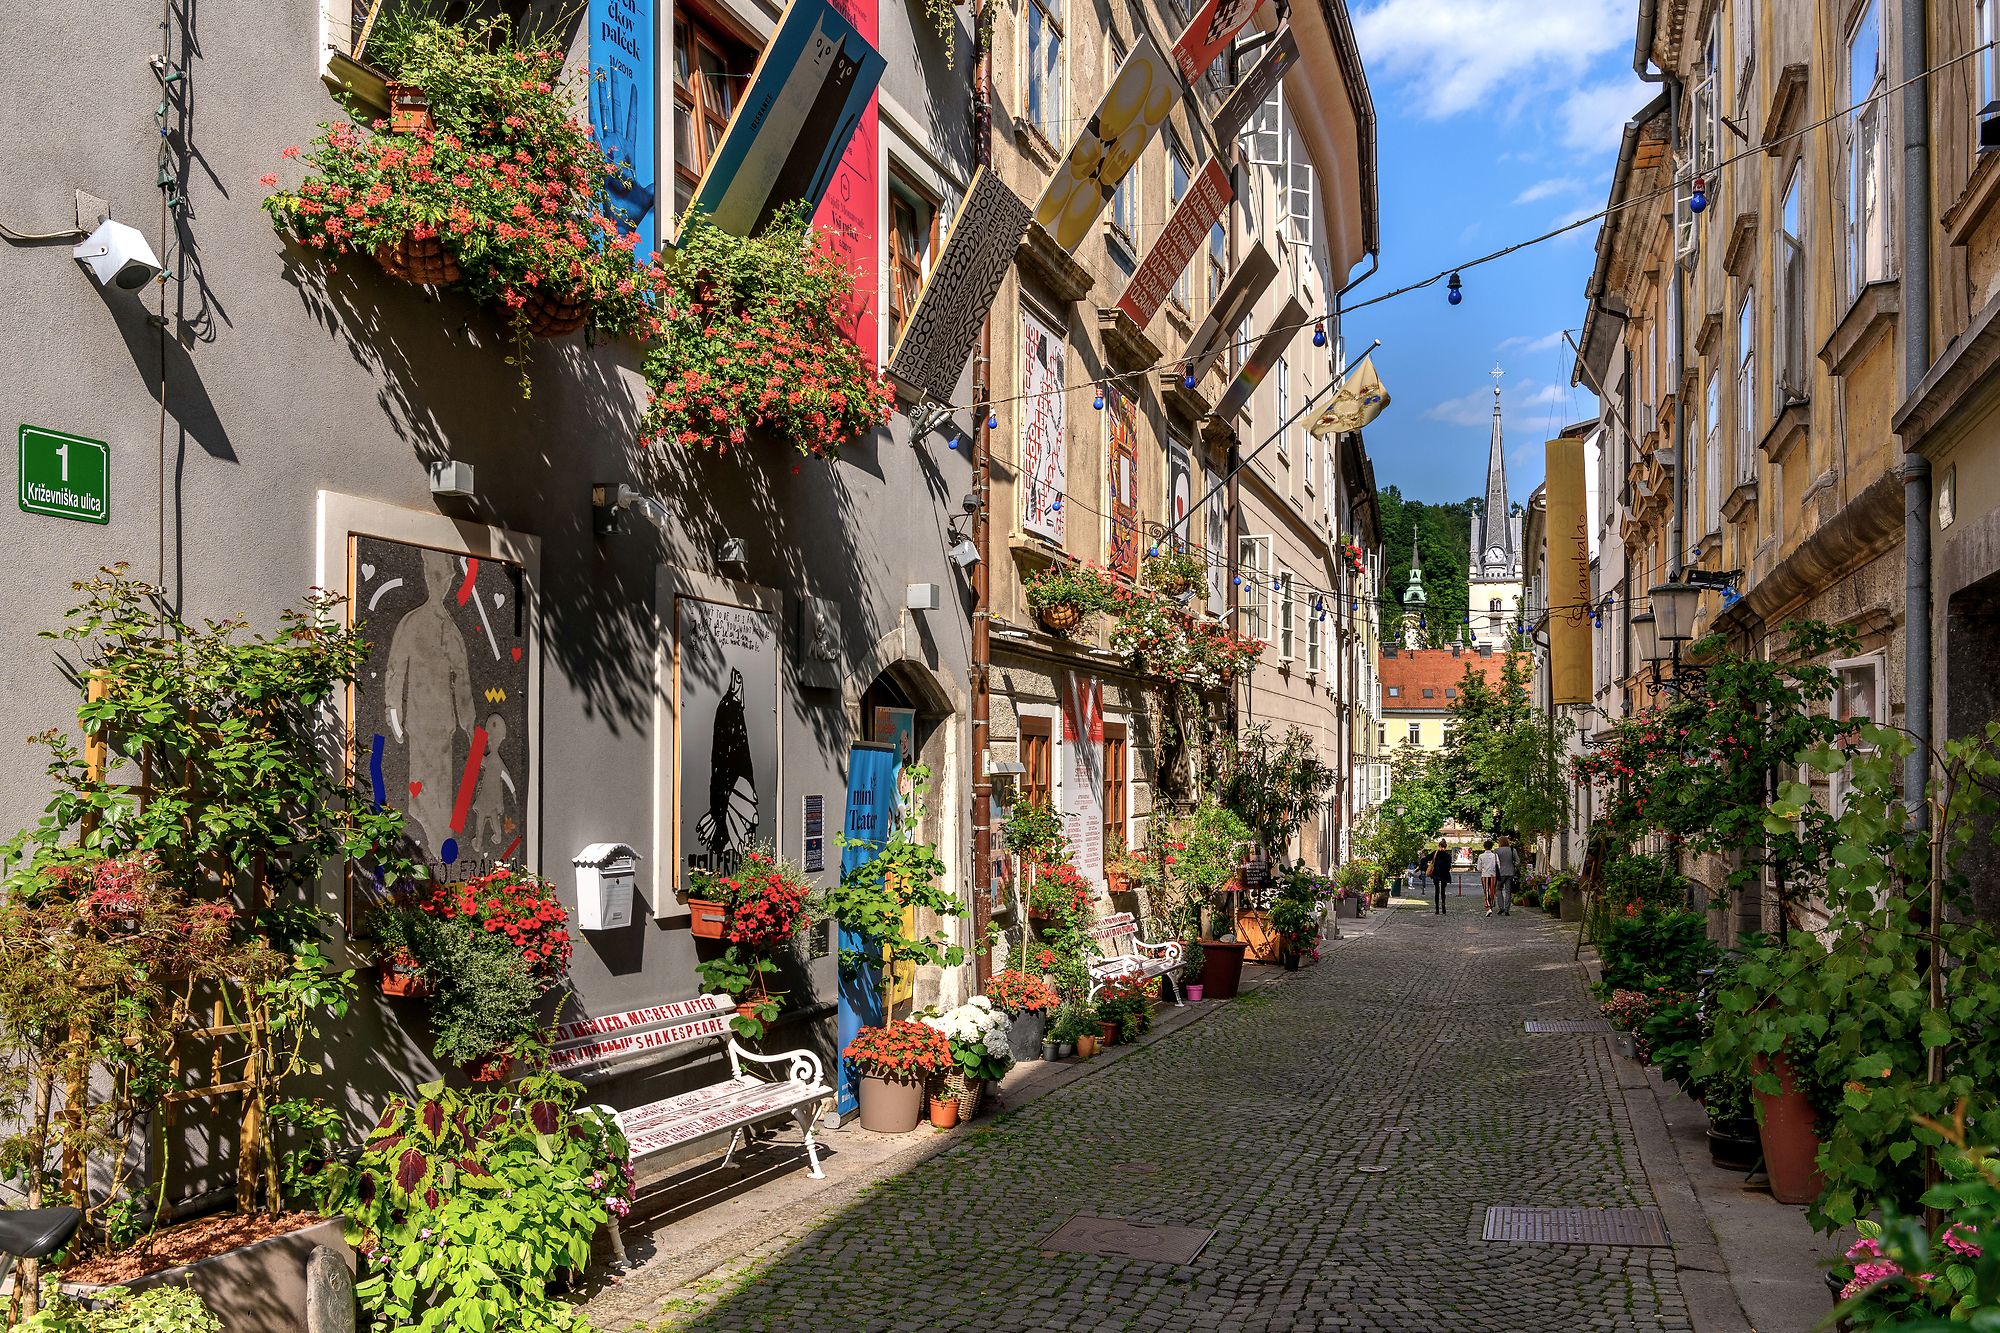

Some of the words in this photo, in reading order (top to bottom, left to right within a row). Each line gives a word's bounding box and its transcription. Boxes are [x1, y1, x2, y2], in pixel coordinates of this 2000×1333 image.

[601, 21, 641, 62] palček
[56, 444, 68, 481] 1
[28, 482, 79, 508] Križevniška
[80, 493, 101, 512] ulica
[1567, 515, 1592, 628] Shambala
[852, 784, 875, 806] mini
[849, 809, 877, 831] Teater
[627, 1004, 683, 1027] MACBETH
[684, 997, 717, 1014] AFTER
[635, 1018, 725, 1049] SHAKESPEARE
